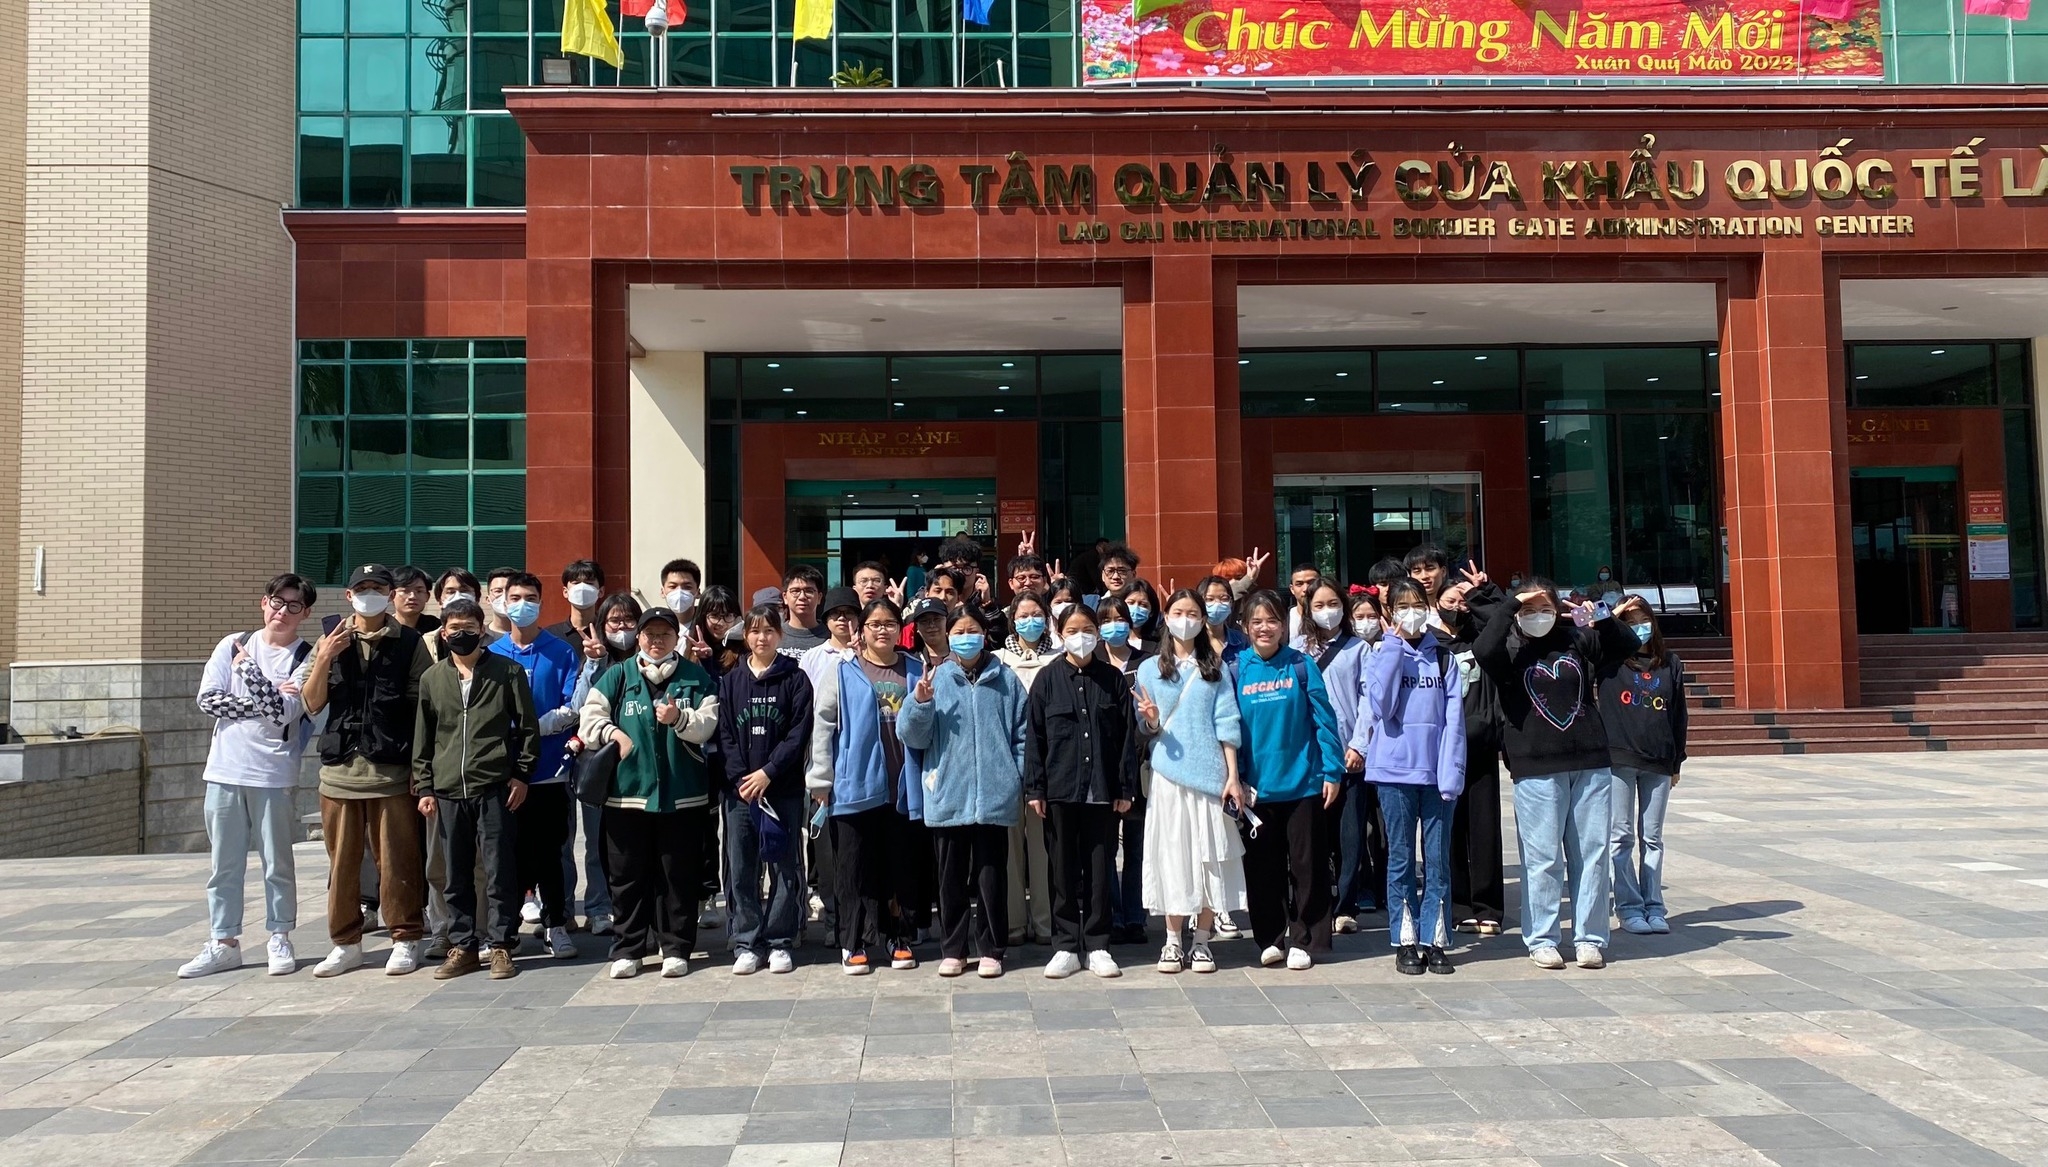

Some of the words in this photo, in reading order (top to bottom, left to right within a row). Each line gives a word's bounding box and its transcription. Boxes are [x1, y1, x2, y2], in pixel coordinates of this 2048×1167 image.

[1183, 8, 1331, 52] Chúc
[1348, 7, 1511, 62] Mừng
[1531, 9, 1662, 50] Năm
[1681, 9, 1786, 51] Mới
[1574, 54, 1631, 70] Xuân
[1637, 54, 1681, 74] Quý
[1740, 55, 1795, 71] 2023
[730, 163, 939, 206] TRUNG
[959, 150, 1092, 205] TÂM
[1113, 142, 1286, 205] QUẢN
[1307, 147, 1375, 201] LÝ
[1394, 140, 1522, 201] CỬA
[1541, 133, 1706, 201] KHẨU
[1725, 137, 1894, 201] QUỐC
[1911, 137, 1986, 198] TẾ
[1058, 221, 1109, 242] LAO
[1119, 221, 1163, 242] CAI
[1172, 219, 1380, 240] INTERNATIONAL
[1393, 217, 1497, 237] BORDER
[1507, 217, 1576, 237] GATE
[1585, 216, 1803, 237] ADMINISTRATION
[1815, 215, 1915, 235] CENTER
[818, 428, 887, 447] NHẬP
[895, 426, 962, 445] CẢNH
[1847, 434, 1891, 442] XIT
[851, 446, 931, 456] ENTRY
